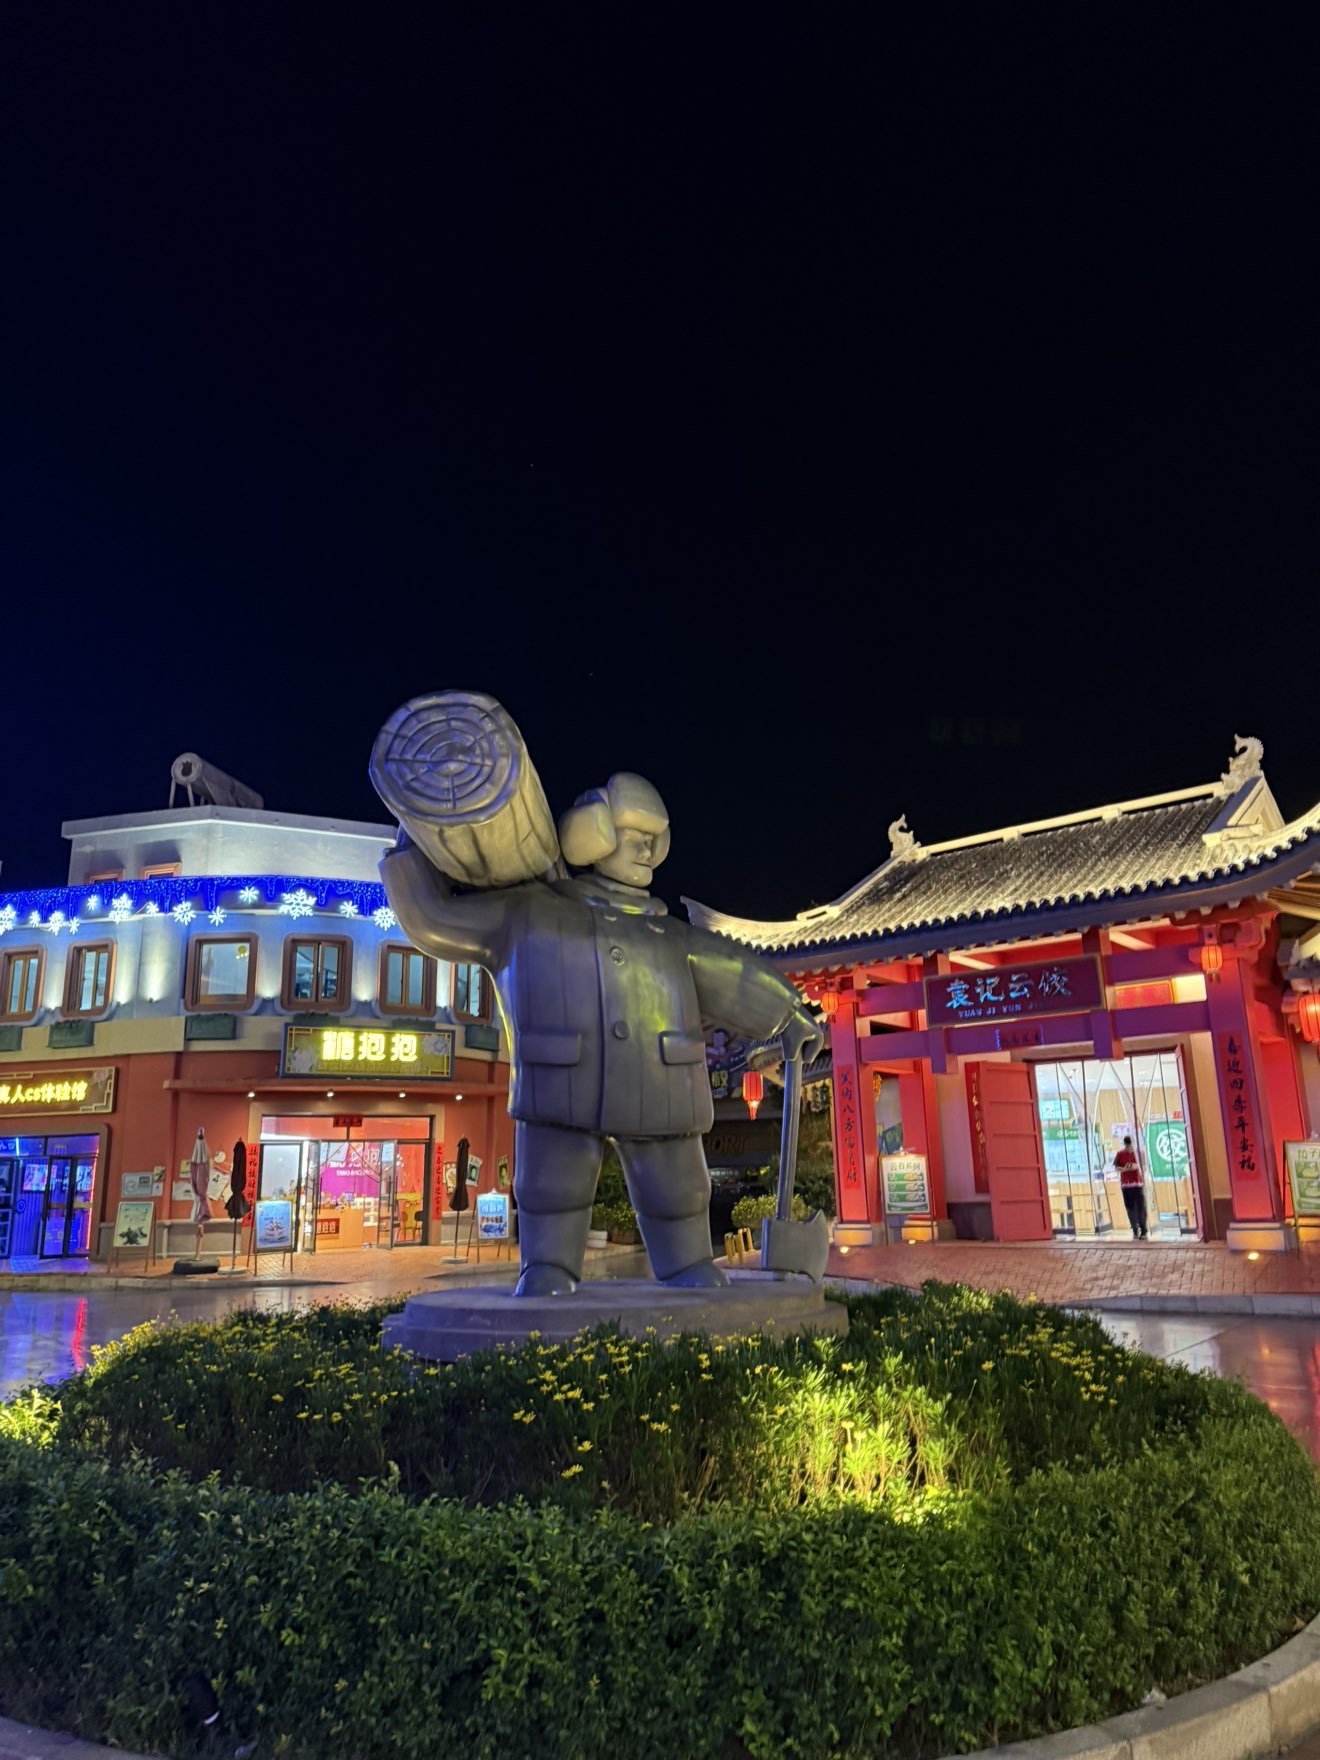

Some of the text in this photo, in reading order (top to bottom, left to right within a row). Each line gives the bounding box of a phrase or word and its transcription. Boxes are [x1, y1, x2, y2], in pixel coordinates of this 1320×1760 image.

[945, 967, 1072, 1010] 袁记云饺
[958, 1008, 982, 1019] YUAN
[1002, 1003, 1022, 1014] YUN
[321, 1030, 418, 1062] 糖抱抱
